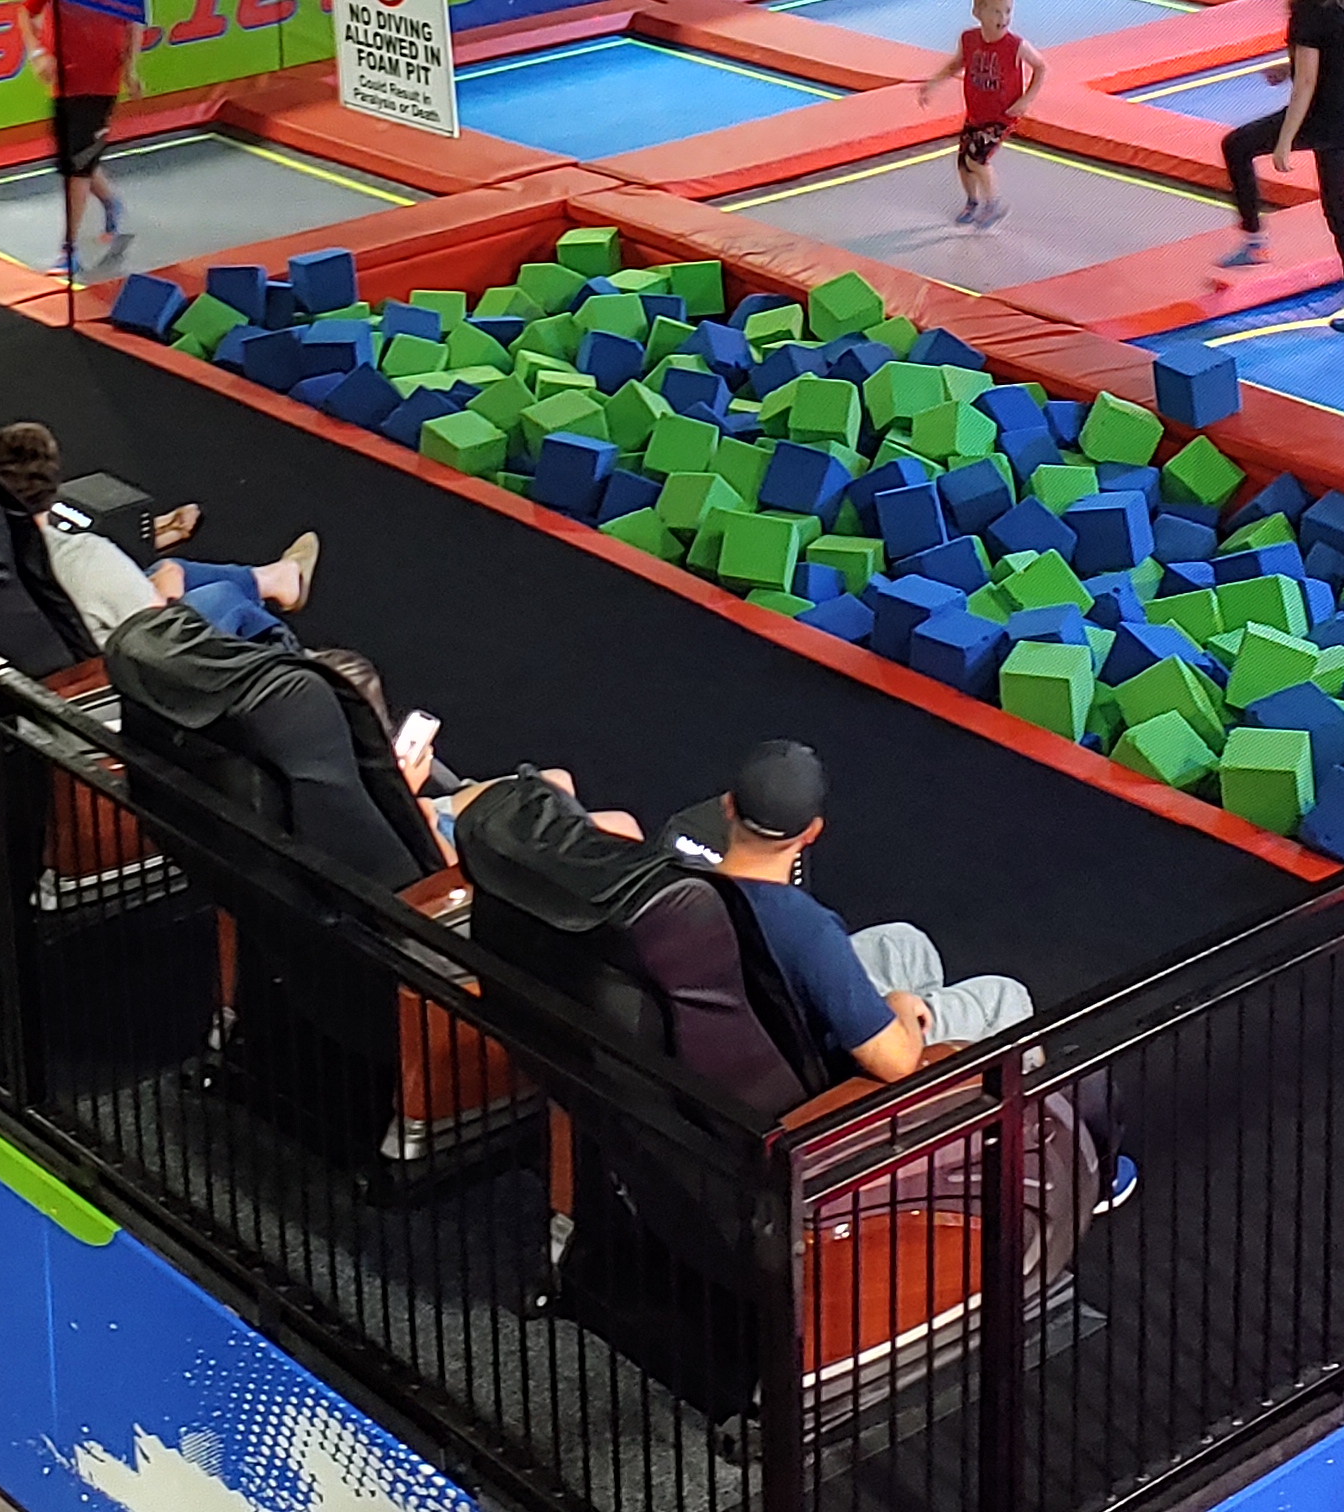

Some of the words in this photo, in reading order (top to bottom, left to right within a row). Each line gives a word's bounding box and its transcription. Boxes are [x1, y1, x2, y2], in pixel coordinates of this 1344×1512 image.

[348, 2, 372, 27] NO
[376, 9, 434, 43] DIVING
[344, 23, 420, 61] ALLOWED
[423, 43, 442, 68] IN
[357, 47, 402, 79] FOAM
[405, 60, 432, 87] PIT
[359, 73, 388, 94] Could
[399, 102, 411, 114] or
